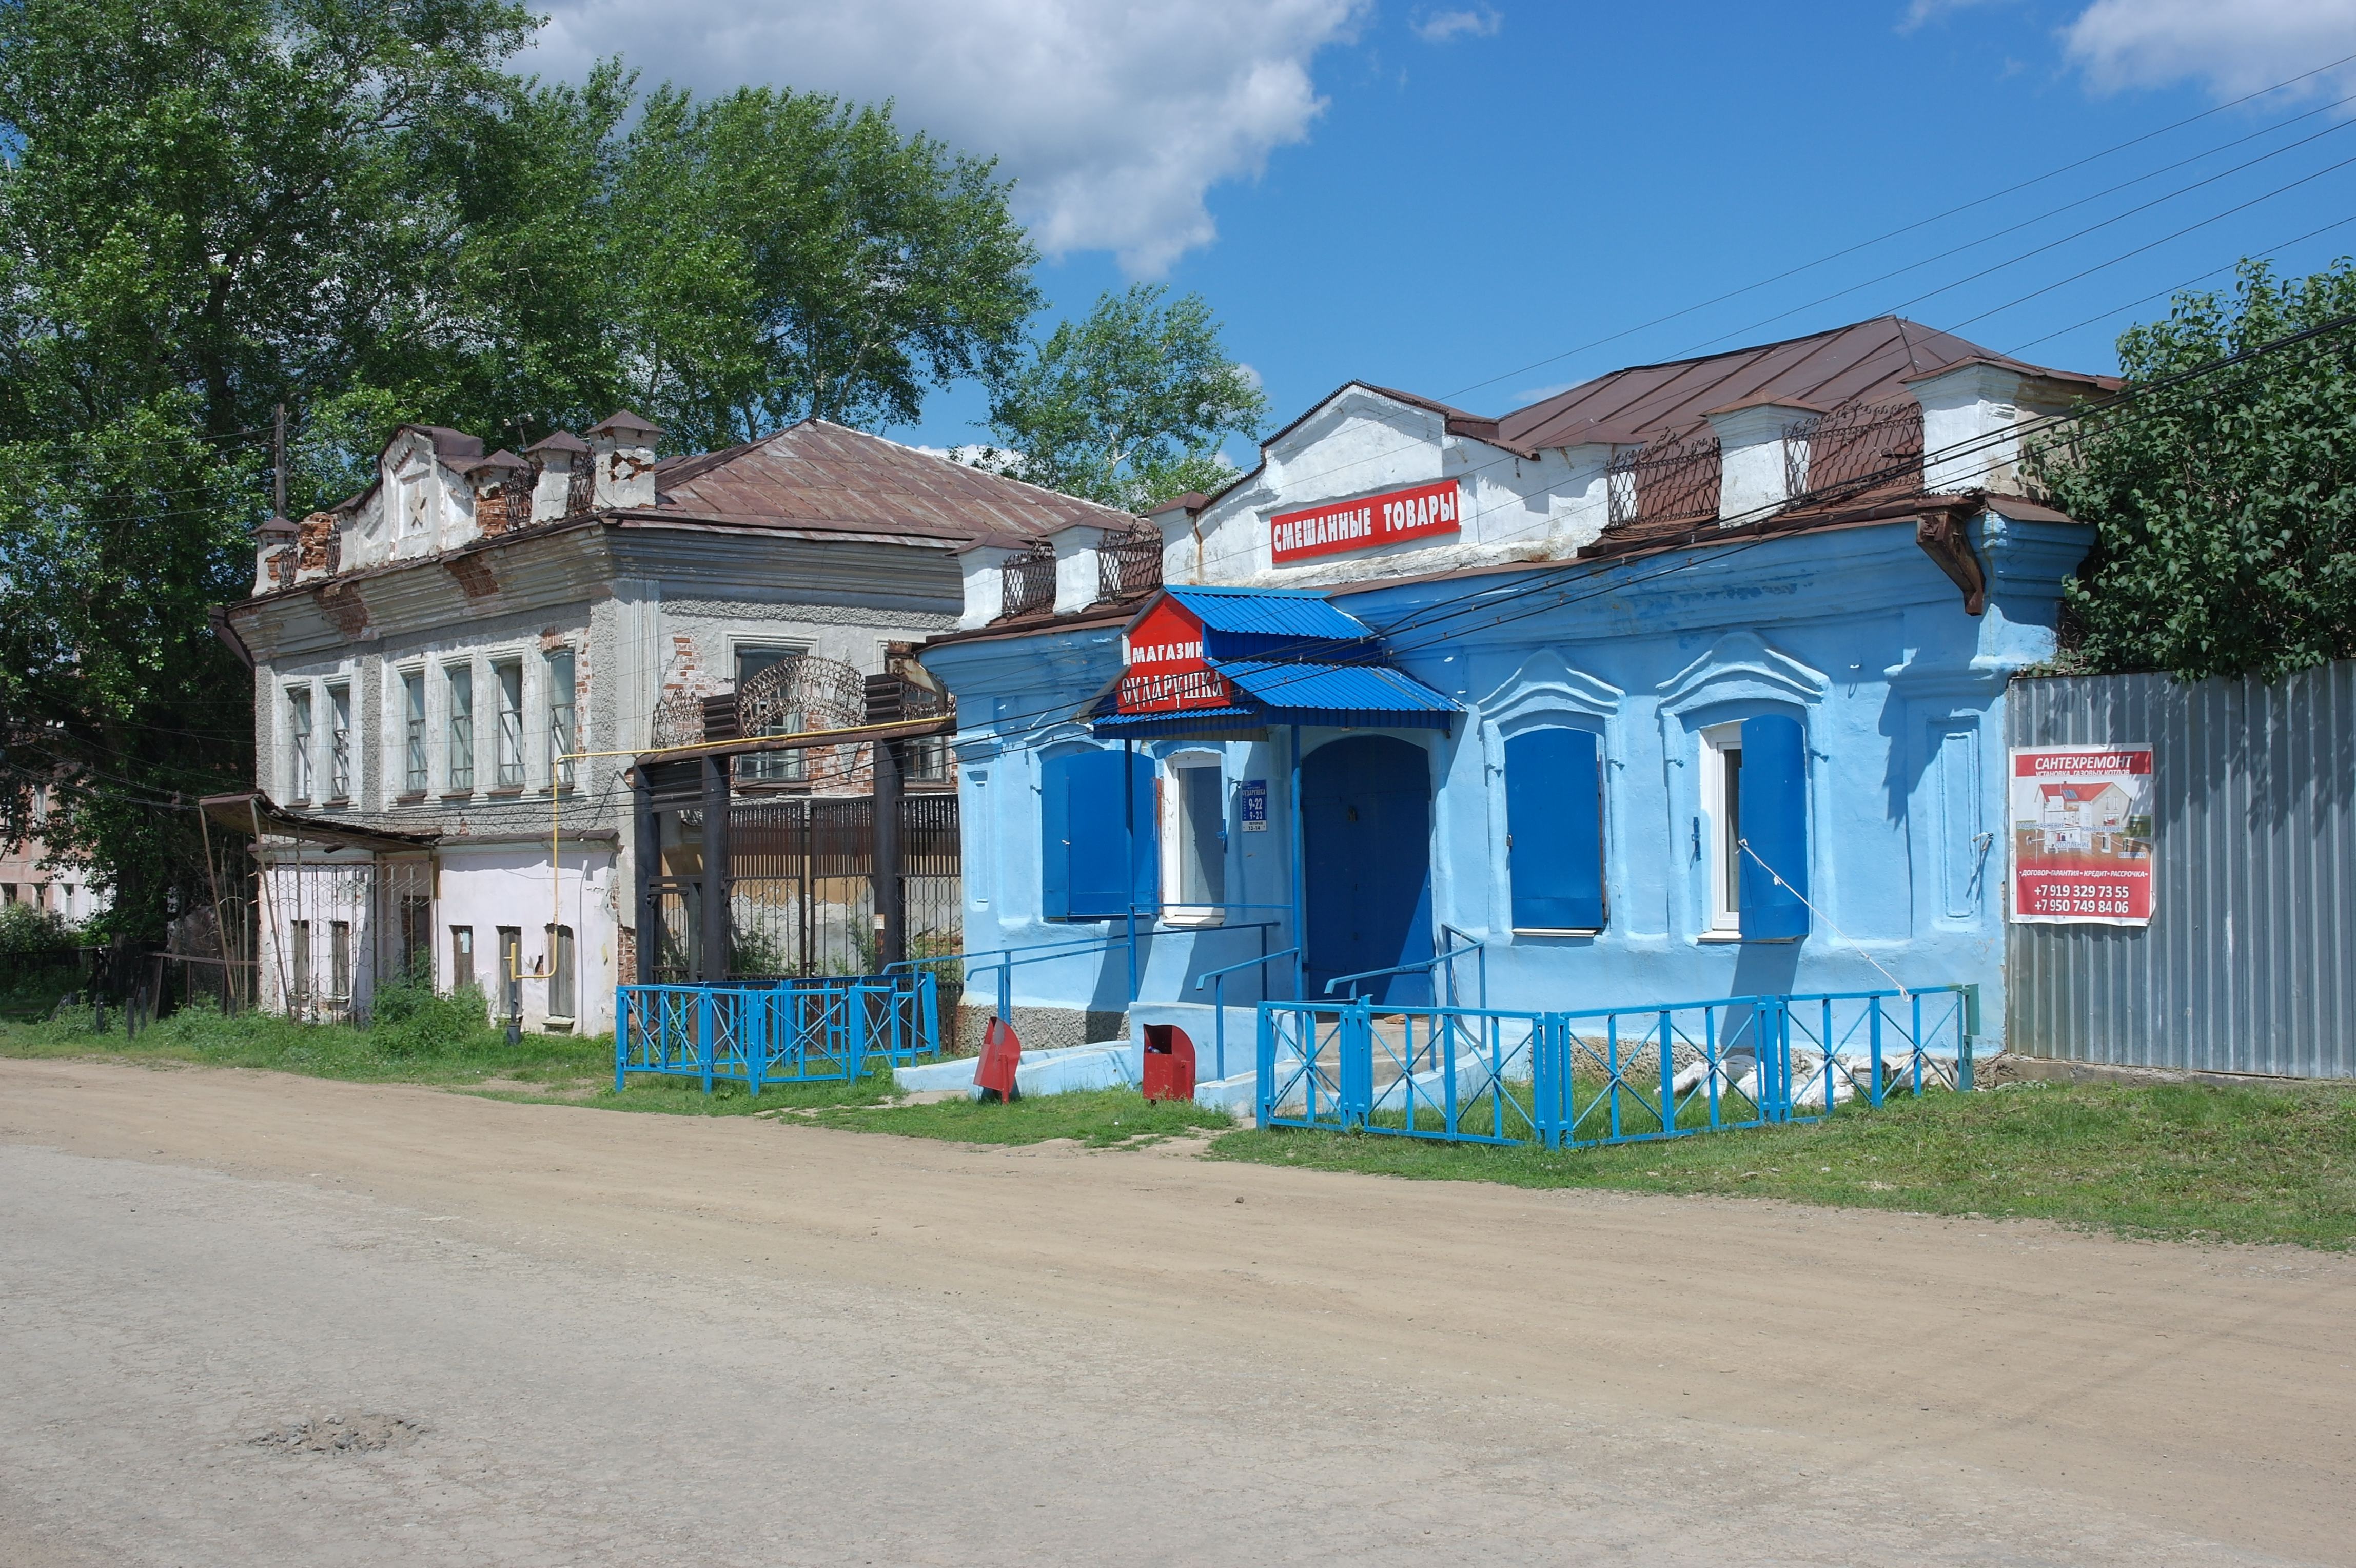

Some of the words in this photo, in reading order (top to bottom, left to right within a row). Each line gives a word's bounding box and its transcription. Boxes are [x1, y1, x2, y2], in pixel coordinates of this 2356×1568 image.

[1273, 507, 1371, 552] СМЕШАННЫЕ
[1383, 492, 1455, 532] ТОВАРЫ
[1132, 641, 1203, 663] МАГАЗИН
[1122, 671, 1224, 710] СУДАРУШКА
[2035, 756, 2133, 770] САНТЕХРЕМОНТ
[1249, 798, 1262, 810] 9-22
[1250, 811, 1262, 819] 9-23
[2034, 885, 2048, 896] +7
[2050, 885, 2070, 897] 919
[2073, 885, 2095, 897] 329
[2098, 886, 2112, 898] 73
[2115, 886, 2129, 898] 55
[2034, 899, 2048, 911] +7
[2050, 899, 2070, 912] 950
[2073, 900, 2095, 912] 749
[2098, 900, 2112, 913] 84
[2115, 901, 2129, 913] 06
